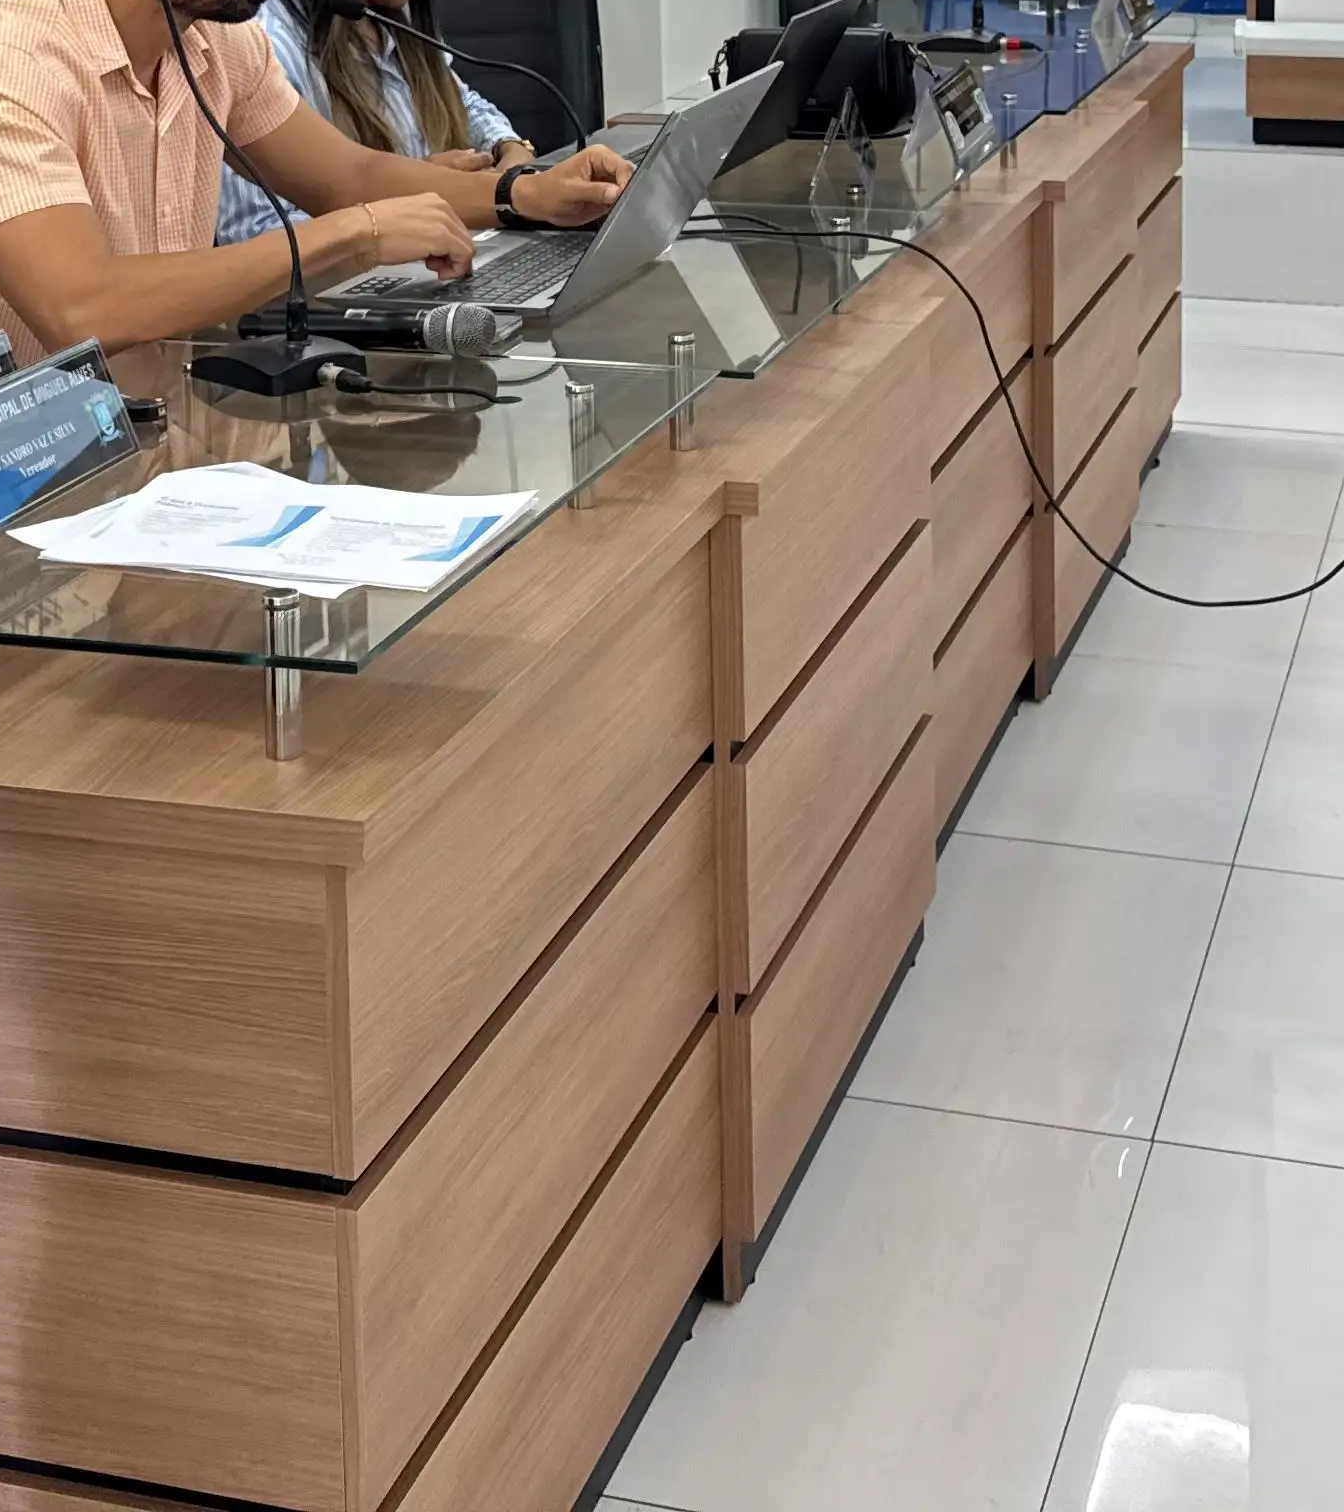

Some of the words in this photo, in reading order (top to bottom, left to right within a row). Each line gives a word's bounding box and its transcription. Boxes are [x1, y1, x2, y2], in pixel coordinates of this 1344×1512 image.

[20, 391, 36, 411] DE
[34, 379, 69, 406] MIGUEL
[68, 362, 96, 388] ALVES
[19, 453, 57, 479] Vereador
